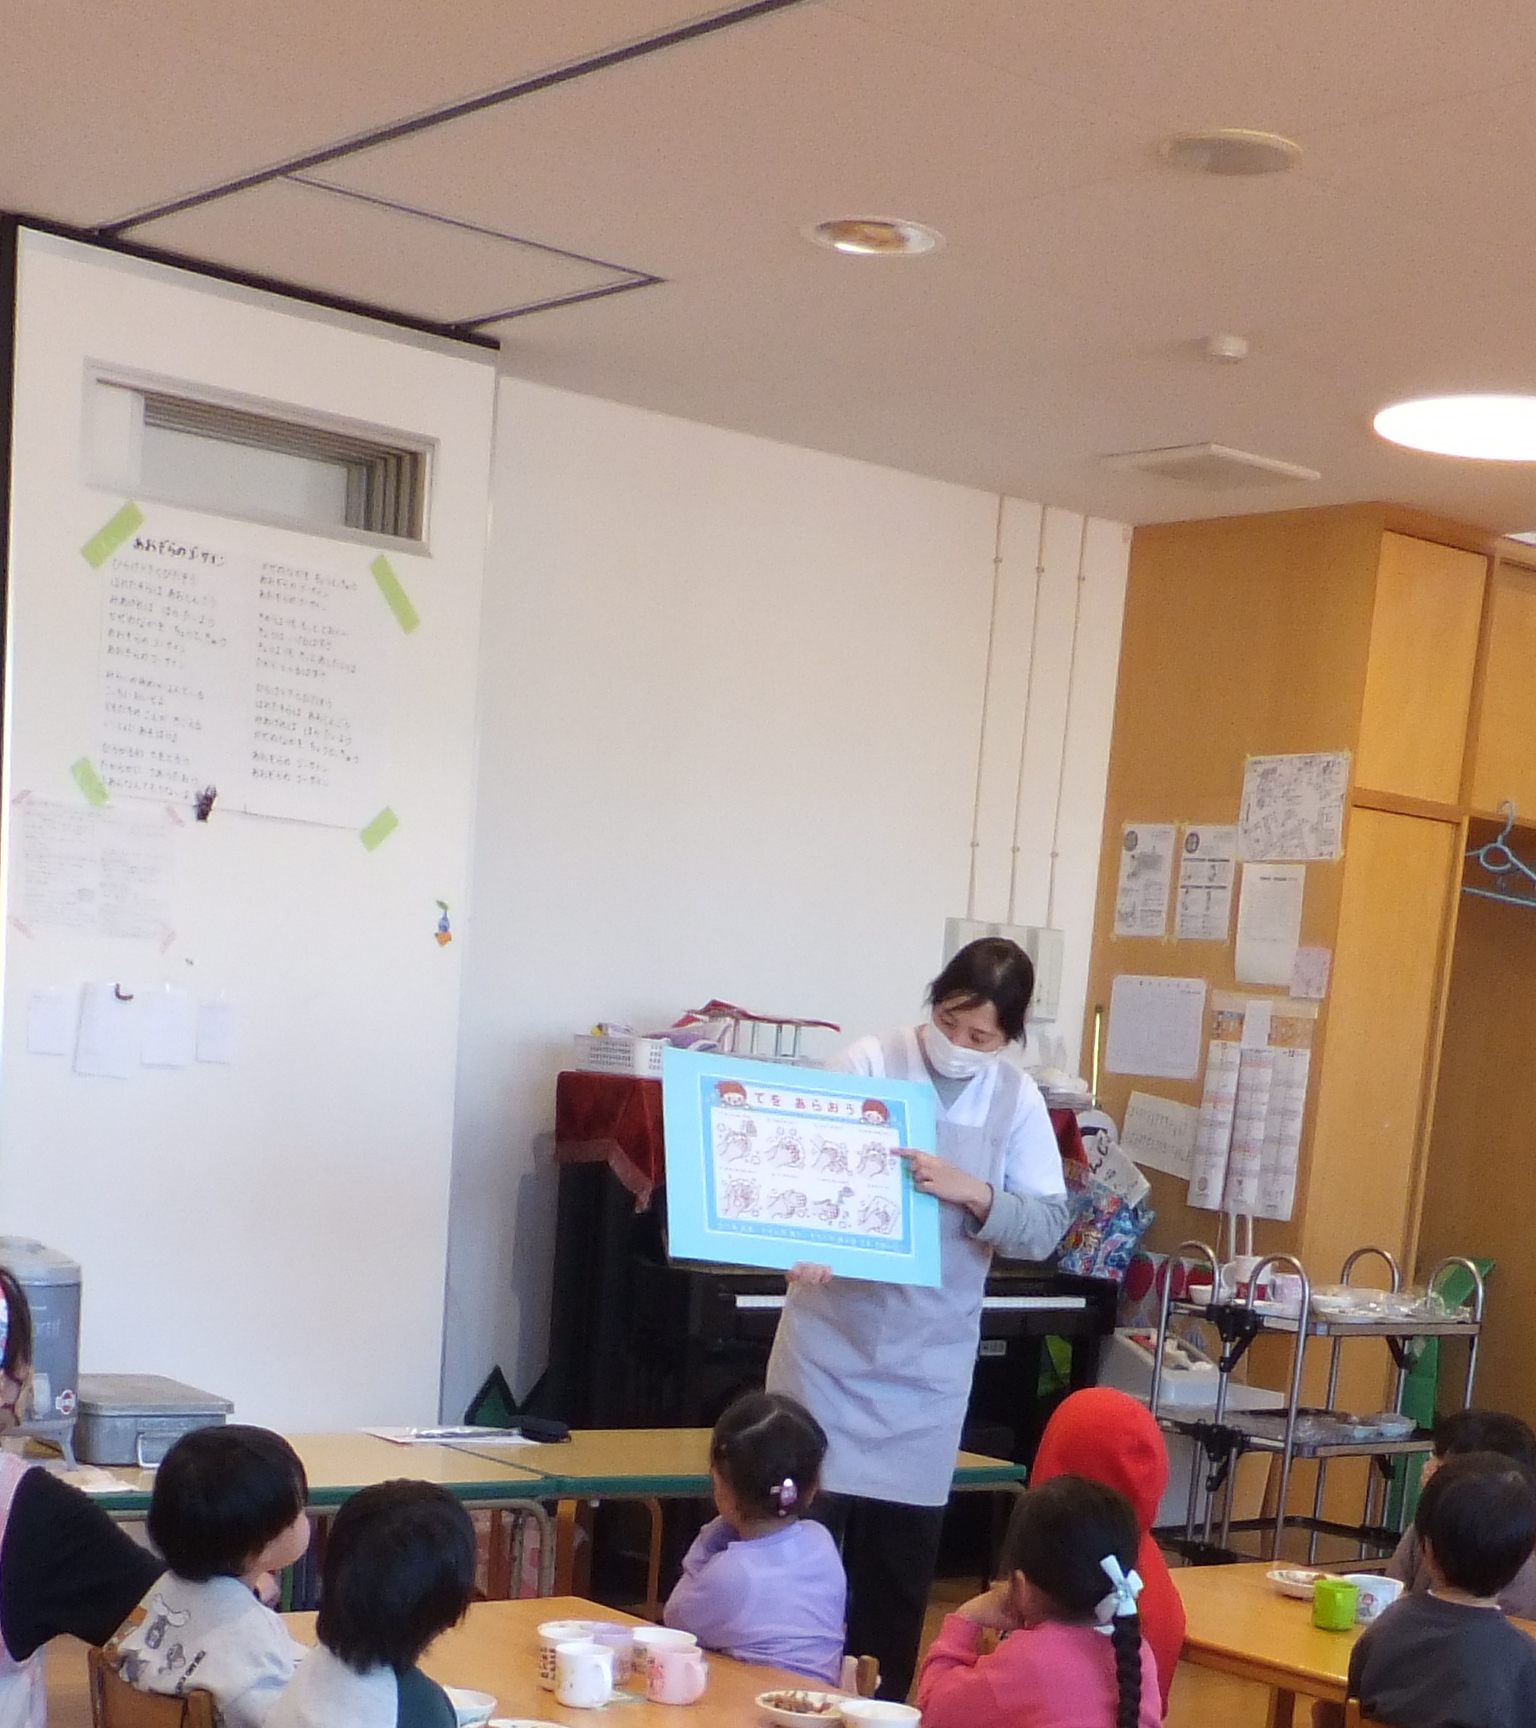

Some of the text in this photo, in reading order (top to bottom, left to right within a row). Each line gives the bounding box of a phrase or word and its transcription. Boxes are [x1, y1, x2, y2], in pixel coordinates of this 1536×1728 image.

[754, 1091, 856, 1116] てを あらおう
